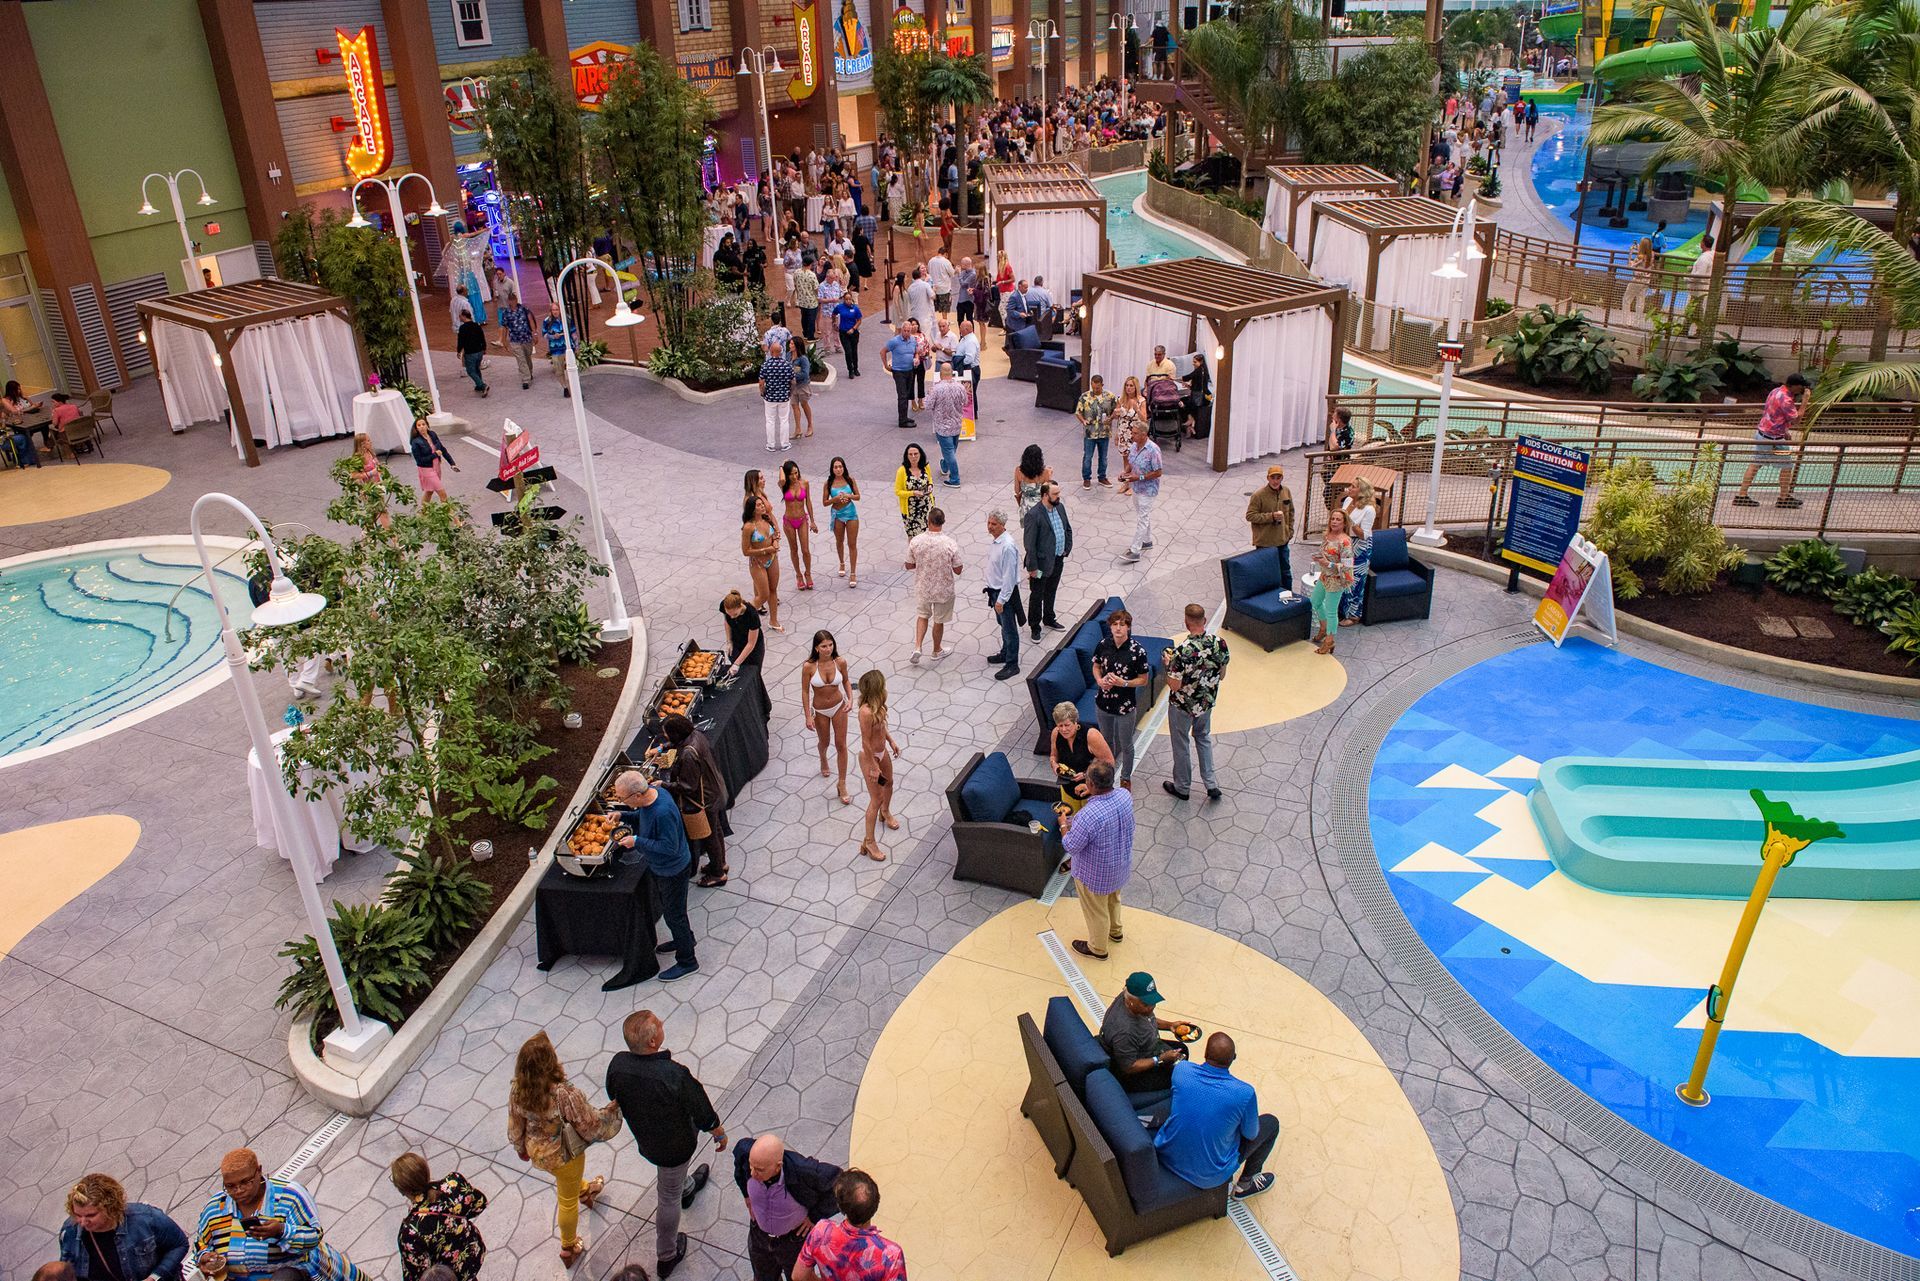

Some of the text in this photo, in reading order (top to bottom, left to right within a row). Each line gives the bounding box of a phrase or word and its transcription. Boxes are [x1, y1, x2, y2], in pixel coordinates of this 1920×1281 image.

[800, 17, 813, 86] ARCADE
[690, 63, 711, 79] FOR
[713, 59, 732, 77] ALL
[835, 52, 873, 75] CE CREAM
[349, 51, 376, 155] ARCADE
[1525, 438, 1583, 461] KIDS COVE AREA
[1529, 449, 1574, 468] ATTENTION
